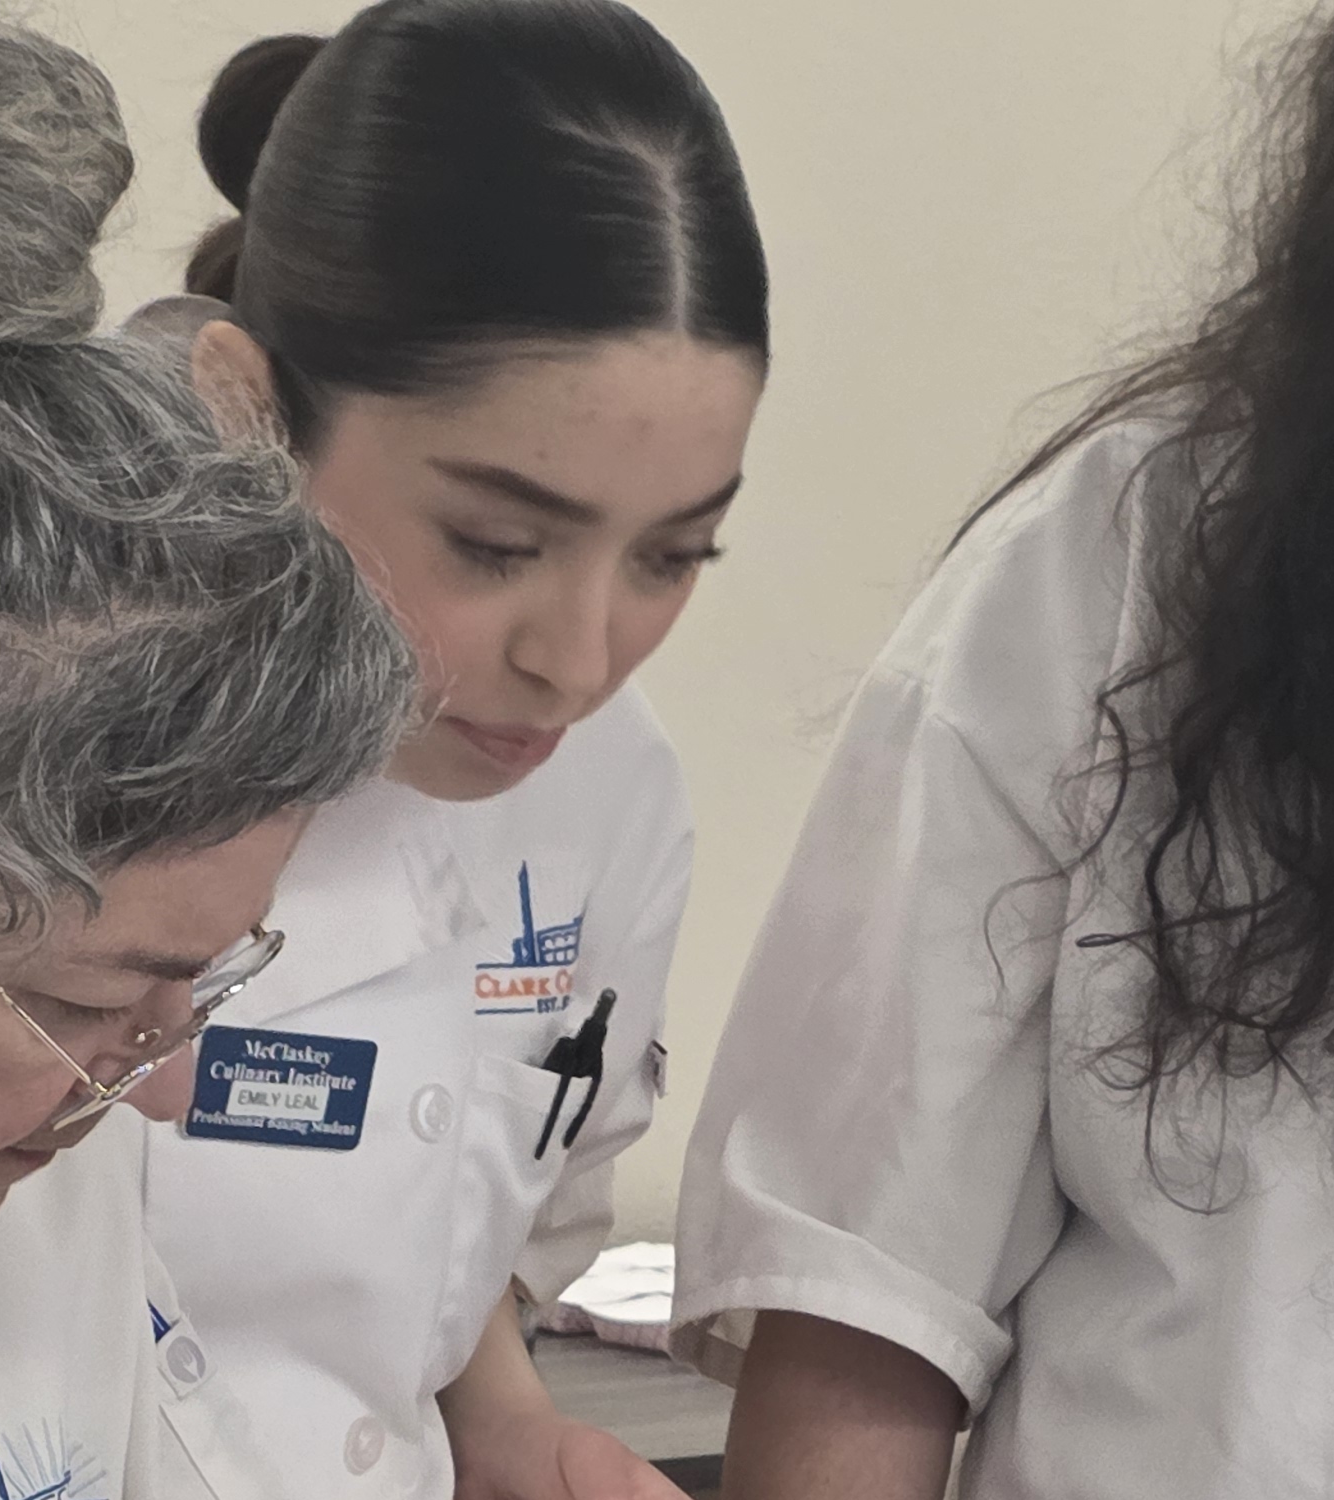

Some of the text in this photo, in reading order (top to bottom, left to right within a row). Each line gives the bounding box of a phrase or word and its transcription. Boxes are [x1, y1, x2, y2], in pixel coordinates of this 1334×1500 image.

[244, 1039, 333, 1069] McClaskey
[209, 1061, 358, 1091] Culinary Institute
[237, 1089, 320, 1110] EMILY LEAL
